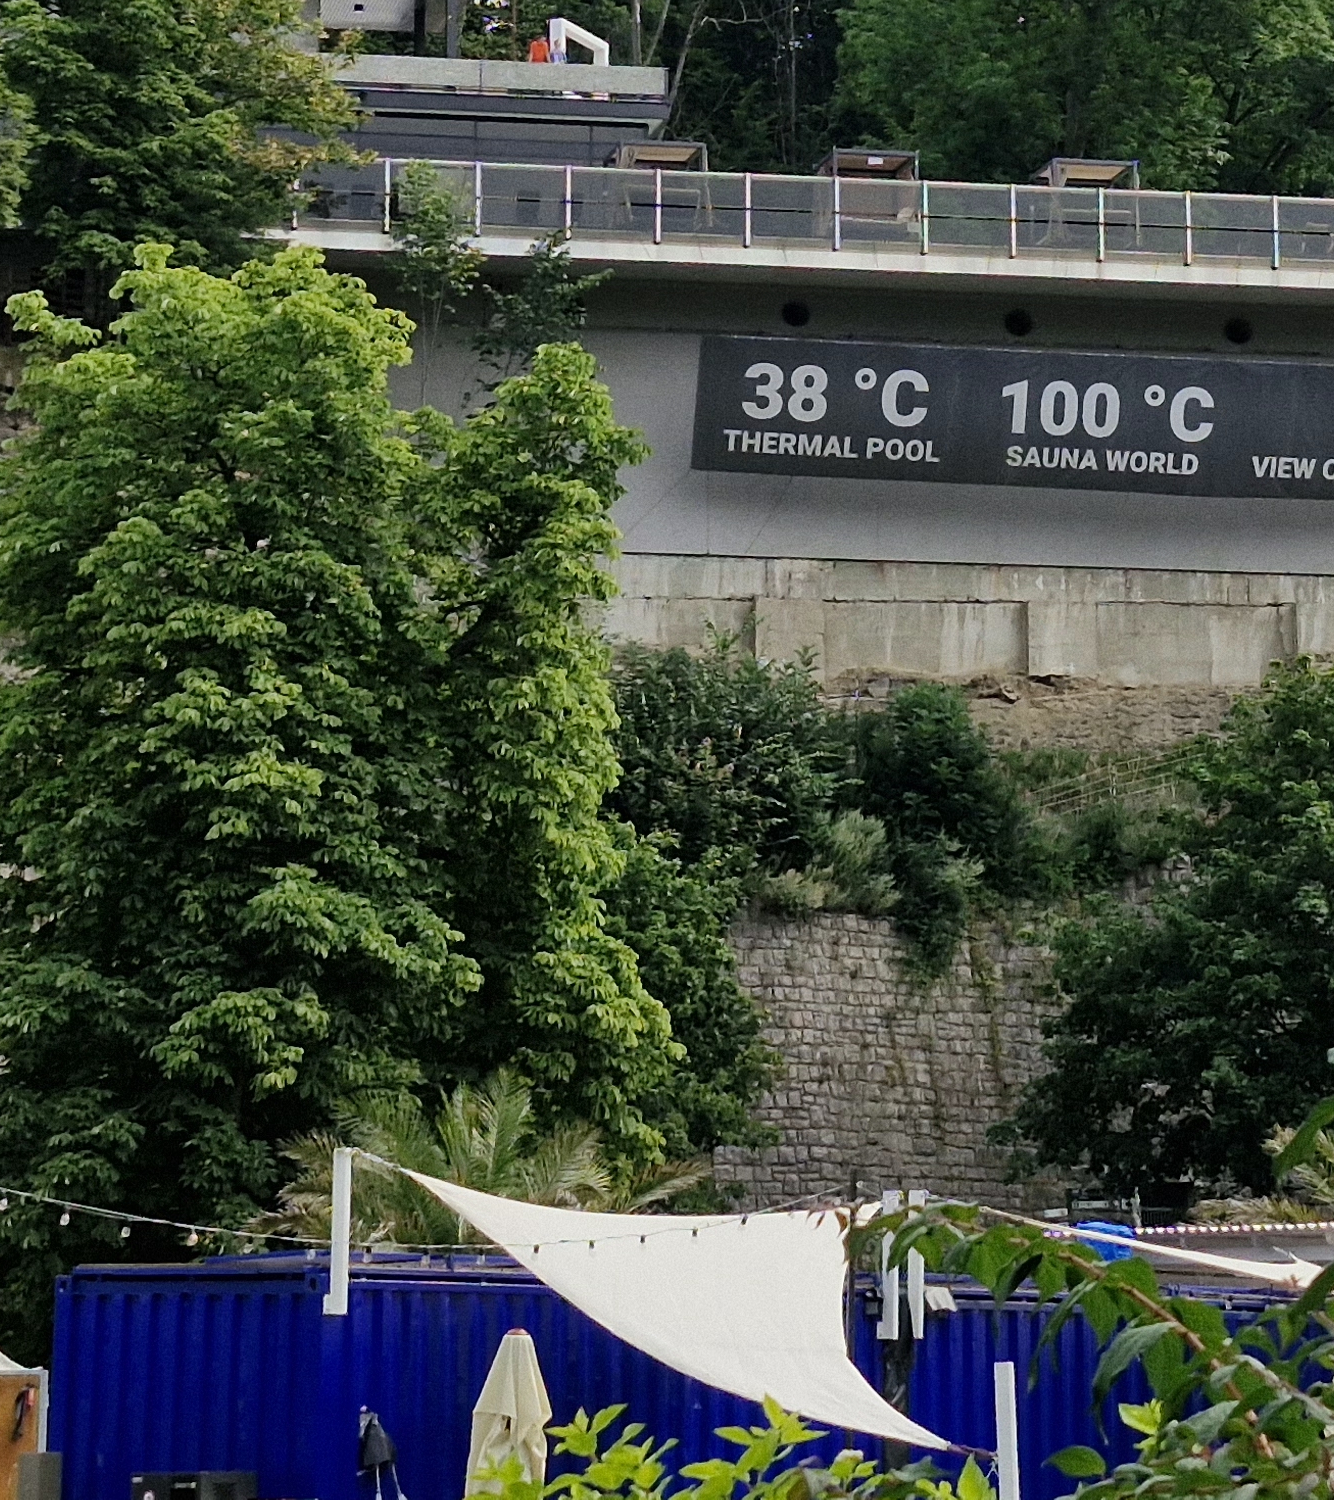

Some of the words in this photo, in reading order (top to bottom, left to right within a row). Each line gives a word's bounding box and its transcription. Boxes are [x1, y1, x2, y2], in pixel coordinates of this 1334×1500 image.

[742, 362, 828, 422] 38
[854, 368, 930, 427] °C
[1001, 379, 1120, 438] 100
[1144, 384, 1215, 442] °C
[723, 429, 858, 459] THERMAL
[866, 437, 940, 463] POOL
[1005, 445, 1098, 470] SAUNA
[1106, 449, 1199, 476] WORLD
[1252, 455, 1316, 480] VIEW
